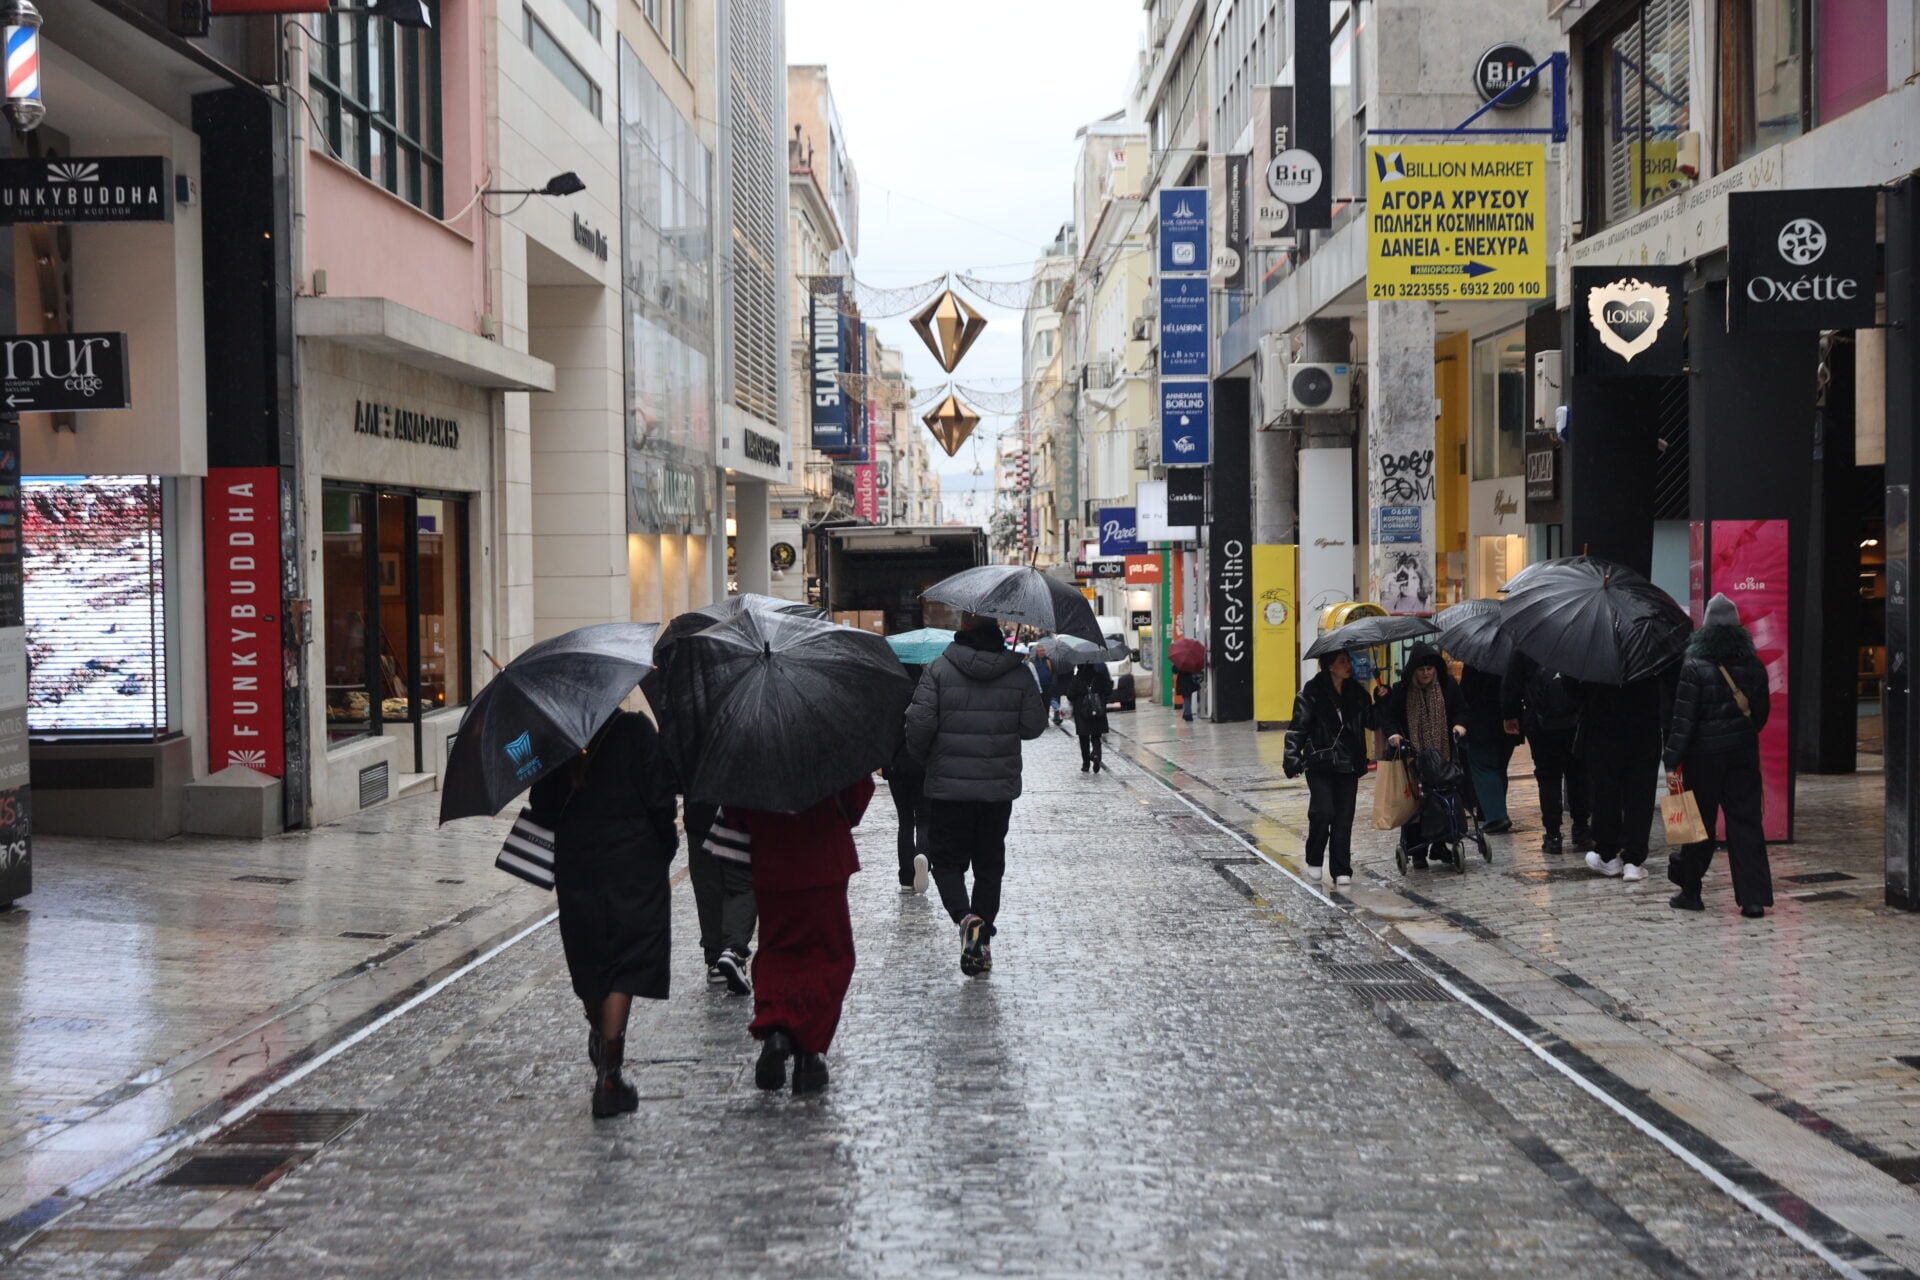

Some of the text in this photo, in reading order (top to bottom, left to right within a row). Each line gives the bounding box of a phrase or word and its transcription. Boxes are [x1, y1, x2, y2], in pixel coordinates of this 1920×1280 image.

[1487, 61, 1531, 87] Big
[1276, 165, 1312, 184] Big
[1406, 161, 1534, 178] BILLION MARKET
[4, 186, 159, 206] UNKYBUDDHA
[1381, 190, 1529, 210] ΑΓΟΡΑ ΧΡΥΣΟΥ
[1260, 206, 1284, 219] Big
[1374, 212, 1534, 233] ΠΩΛΗΣΗ ΚΟΣΜΗΜΑΤΩΝ
[1381, 238, 1440, 257] ΔΑΝΕΙΑ
[1454, 237, 1529, 256] ΕΝΕΧΥΡΑ
[1415, 265, 1464, 274] ΗΜΙΟΡΟΦΟΣ
[1373, 284, 1395, 296] 210
[1399, 283, 1449, 296] 3223555
[1460, 282, 1489, 295] 6932
[1493, 282, 1515, 295] 200
[1519, 281, 1540, 294] 100
[1747, 273, 1858, 303] Oxétte
[1607, 309, 1650, 324] LOISIR
[814, 291, 840, 407] SLAM DUNK
[64, 374, 103, 397] edge
[1103, 520, 1136, 544] Pare
[1734, 582, 1765, 590] LOISIR
[228, 482, 259, 736] FUNKYBUDDHA
[1219, 540, 1244, 662] celestino
